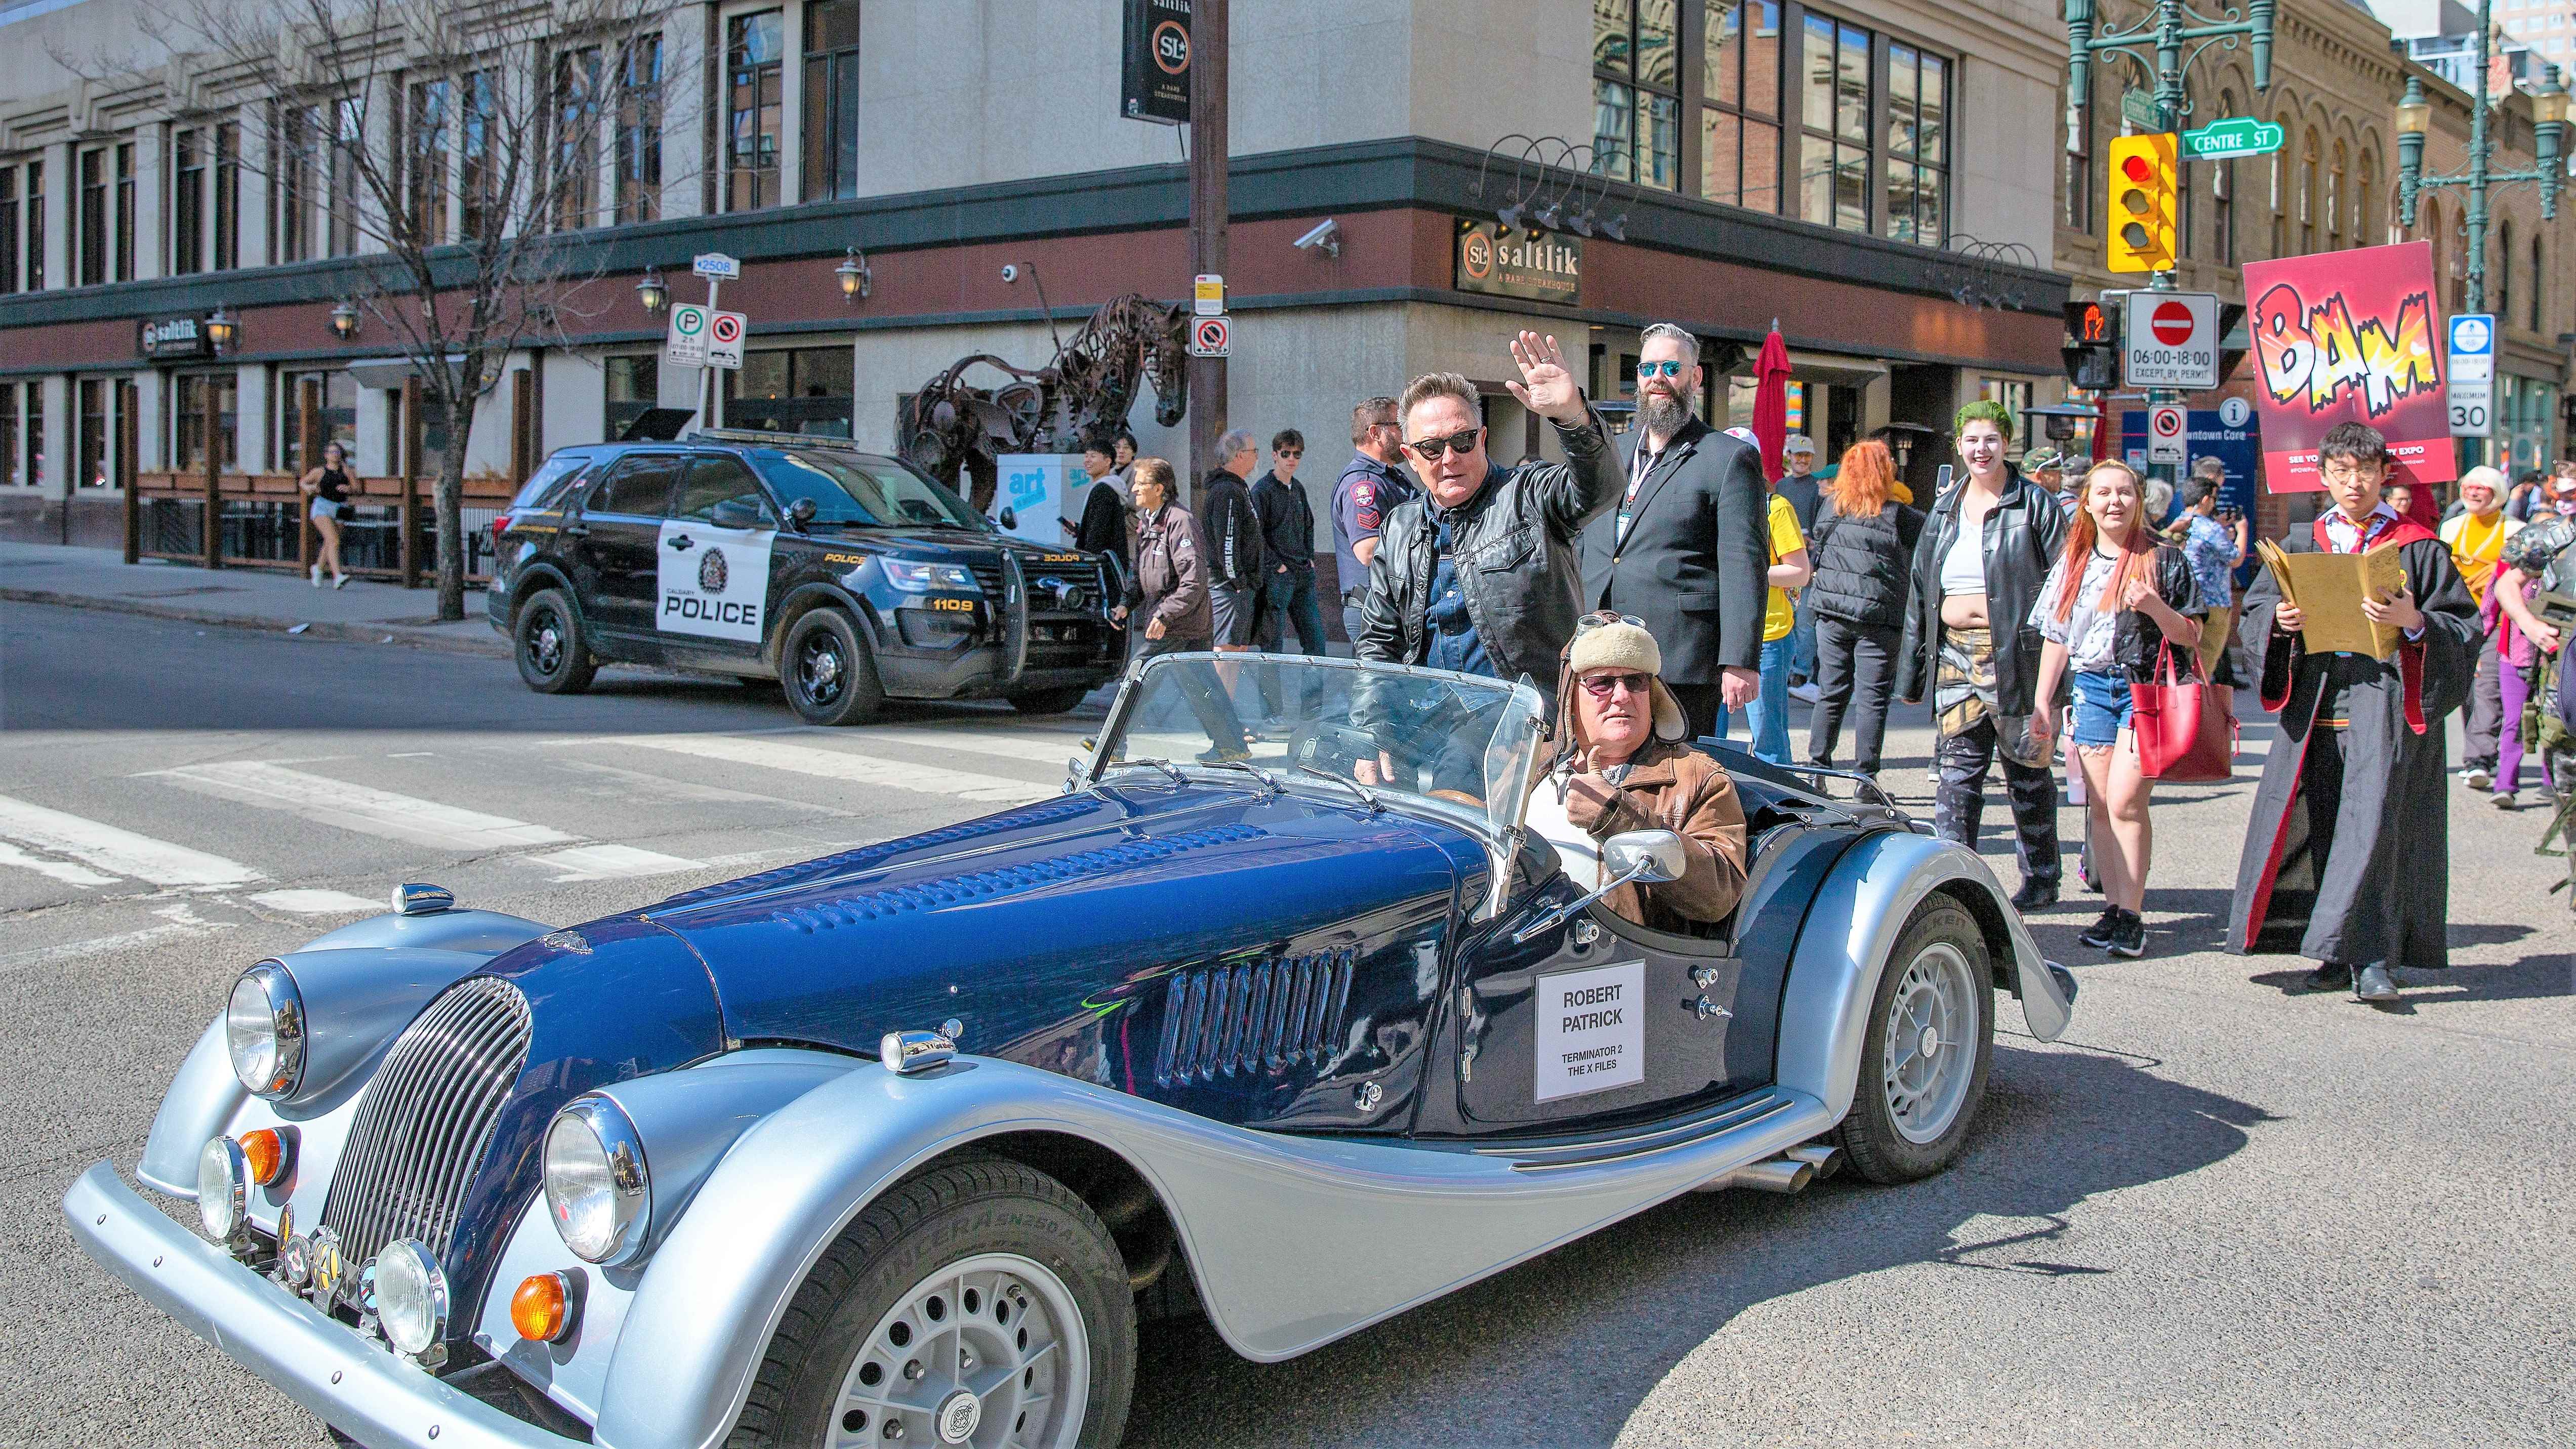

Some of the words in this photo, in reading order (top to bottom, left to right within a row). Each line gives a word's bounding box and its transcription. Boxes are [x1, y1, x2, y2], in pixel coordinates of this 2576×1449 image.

[2194, 133, 2243, 151] CENTRE
[2254, 131, 2269, 147] ST
[703, 259, 730, 272] 2508
[1498, 241, 1578, 275] saltlik
[157, 319, 198, 341] saltlik
[2134, 350, 2209, 365] 06:00-18:00
[2254, 283, 2440, 419] BAM
[2135, 368, 2163, 378] EXCEPT
[2168, 369, 2177, 378] BY
[2181, 369, 2209, 379] PERMIT
[2451, 406, 2485, 426] 30
[2185, 430, 2222, 441] wntown
[2288, 456, 2304, 464] SEE
[2305, 454, 2318, 463] YO
[2399, 445, 2425, 455] EXPO
[1009, 468, 1045, 494] art
[824, 553, 867, 565] POLICE
[665, 597, 756, 626] POLICE
[933, 598, 973, 611] 1109
[1564, 984, 1622, 1008] ROBERT
[1563, 1008, 1623, 1033] PATRICK
[1562, 1046, 1616, 1063] TERMINATOR
[1618, 1045, 1622, 1054] 2
[1568, 1065, 1585, 1077] THE
[1587, 1063, 1592, 1073] X
[1595, 1059, 1616, 1072] FILES
[359, 1259, 375, 1276] MORGAN
[950, 1404, 972, 1432] MORGAN
